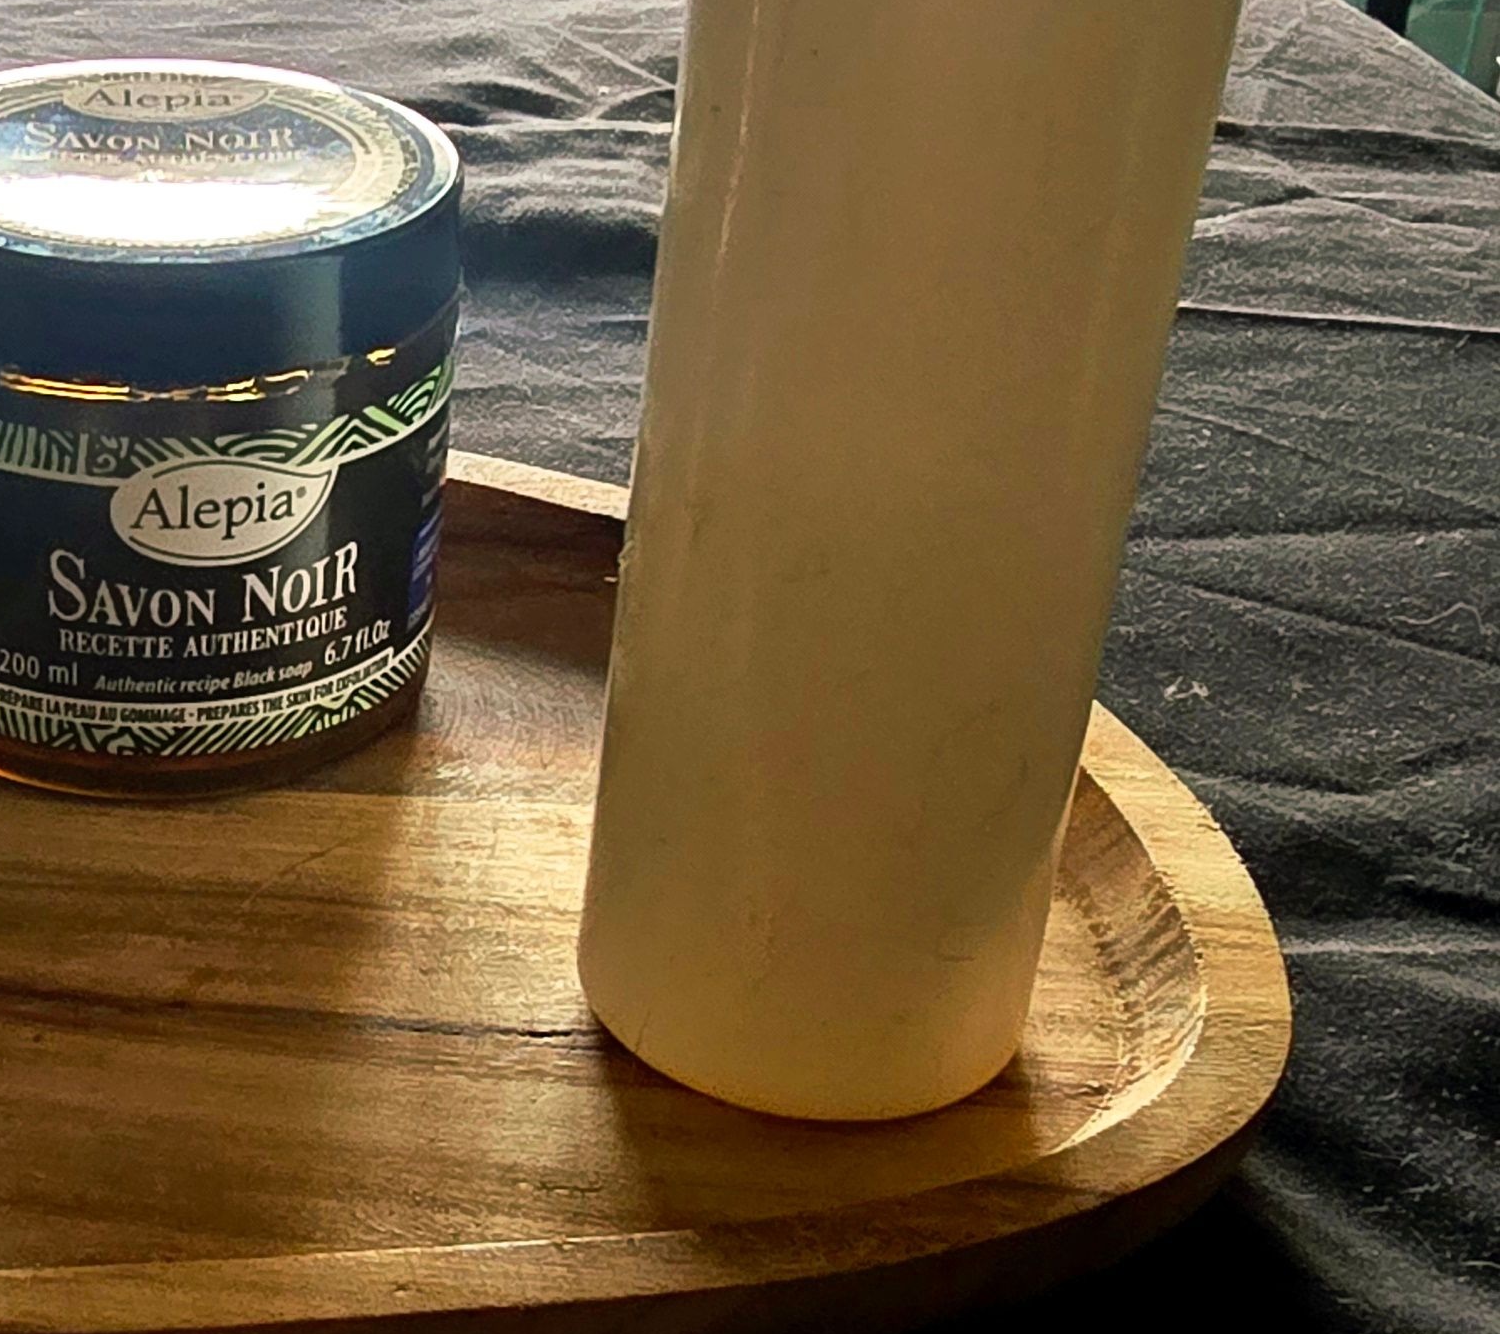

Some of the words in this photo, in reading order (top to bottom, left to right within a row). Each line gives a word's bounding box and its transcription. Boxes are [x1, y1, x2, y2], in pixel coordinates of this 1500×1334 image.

[24, 122, 160, 151] SAVON
[185, 127, 296, 150] NOIR
[48, 548, 216, 627] SAVON
[242, 541, 358, 622] NOIR
[59, 628, 174, 659] RECETTE
[183, 605, 348, 658] AUTHENTIQUE
[0, 649, 40, 679] 200
[48, 661, 78, 686] ml
[324, 635, 353, 665] 6.7
[94, 675, 175, 694] Authentic
[179, 675, 230, 695] recipe
[232, 668, 276, 689] Black
[278, 660, 313, 681] soap
[46, 699, 61, 716] LA
